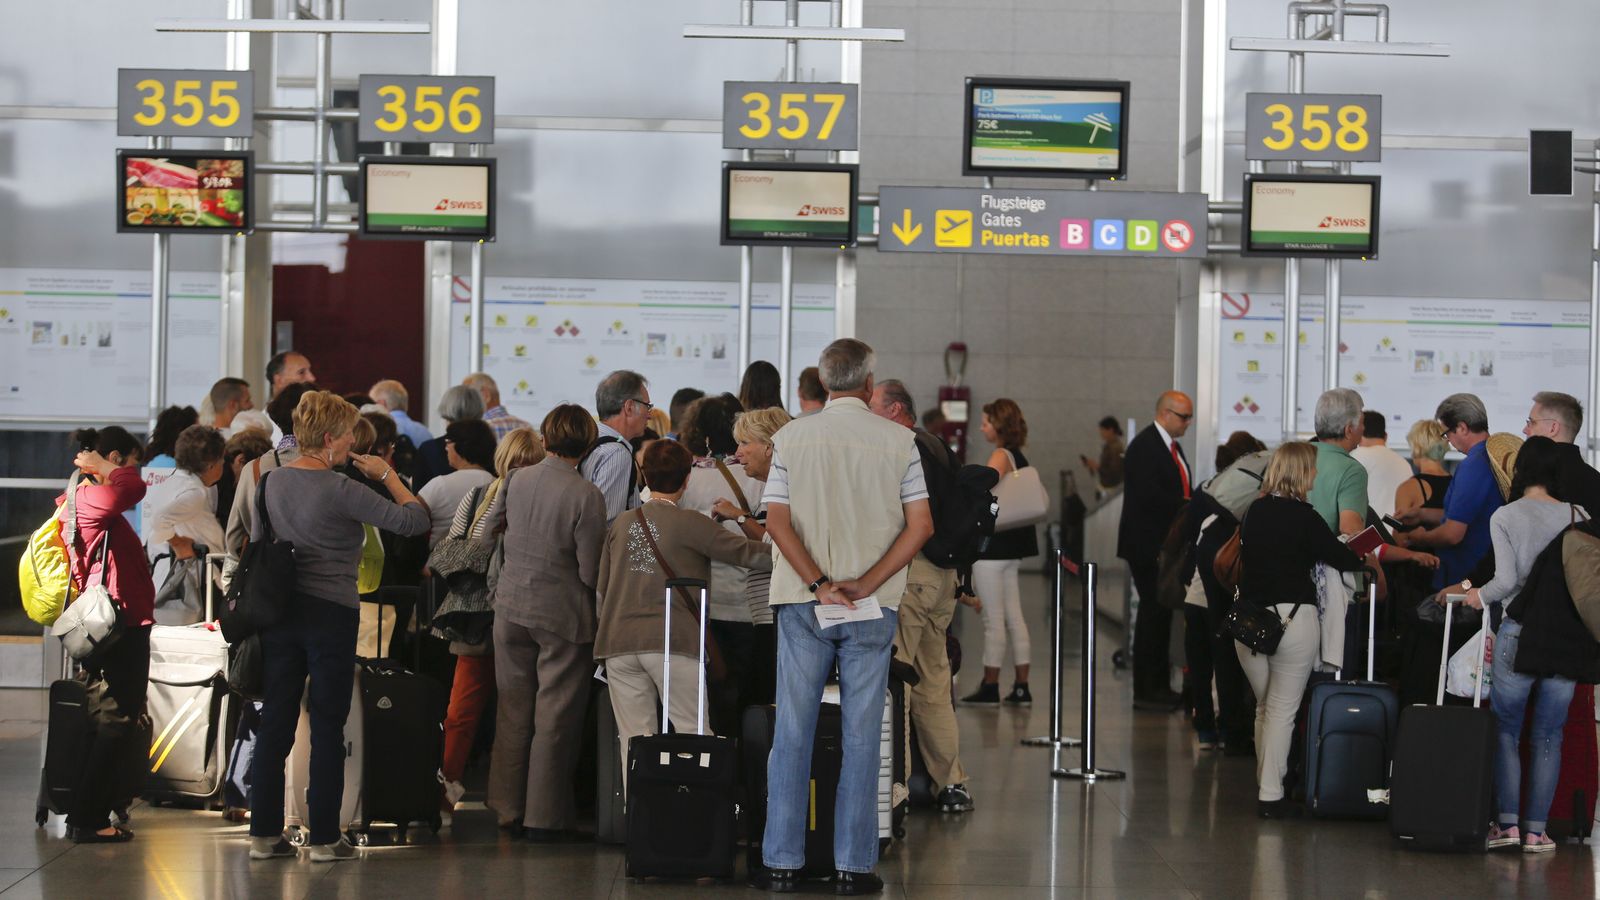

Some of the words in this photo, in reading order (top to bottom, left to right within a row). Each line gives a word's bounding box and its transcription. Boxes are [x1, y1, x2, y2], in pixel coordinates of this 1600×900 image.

[134, 79, 241, 127] 355
[375, 85, 482, 134] 356
[739, 92, 845, 140] 357
[1263, 103, 1369, 152] 358
[371, 167, 411, 178] Economy
[734, 173, 774, 184] Economy
[1256, 185, 1296, 196] Economy
[450, 200, 483, 209] SWISS
[811, 206, 845, 215] SWISS
[981, 195, 1047, 212] Flugsteige
[981, 212, 1022, 228] Gates
[1333, 217, 1367, 227] SWISS
[981, 230, 1050, 247] Puertas
[1067, 223, 1084, 245] B
[1100, 223, 1117, 245] C
[1134, 225, 1152, 246] D
